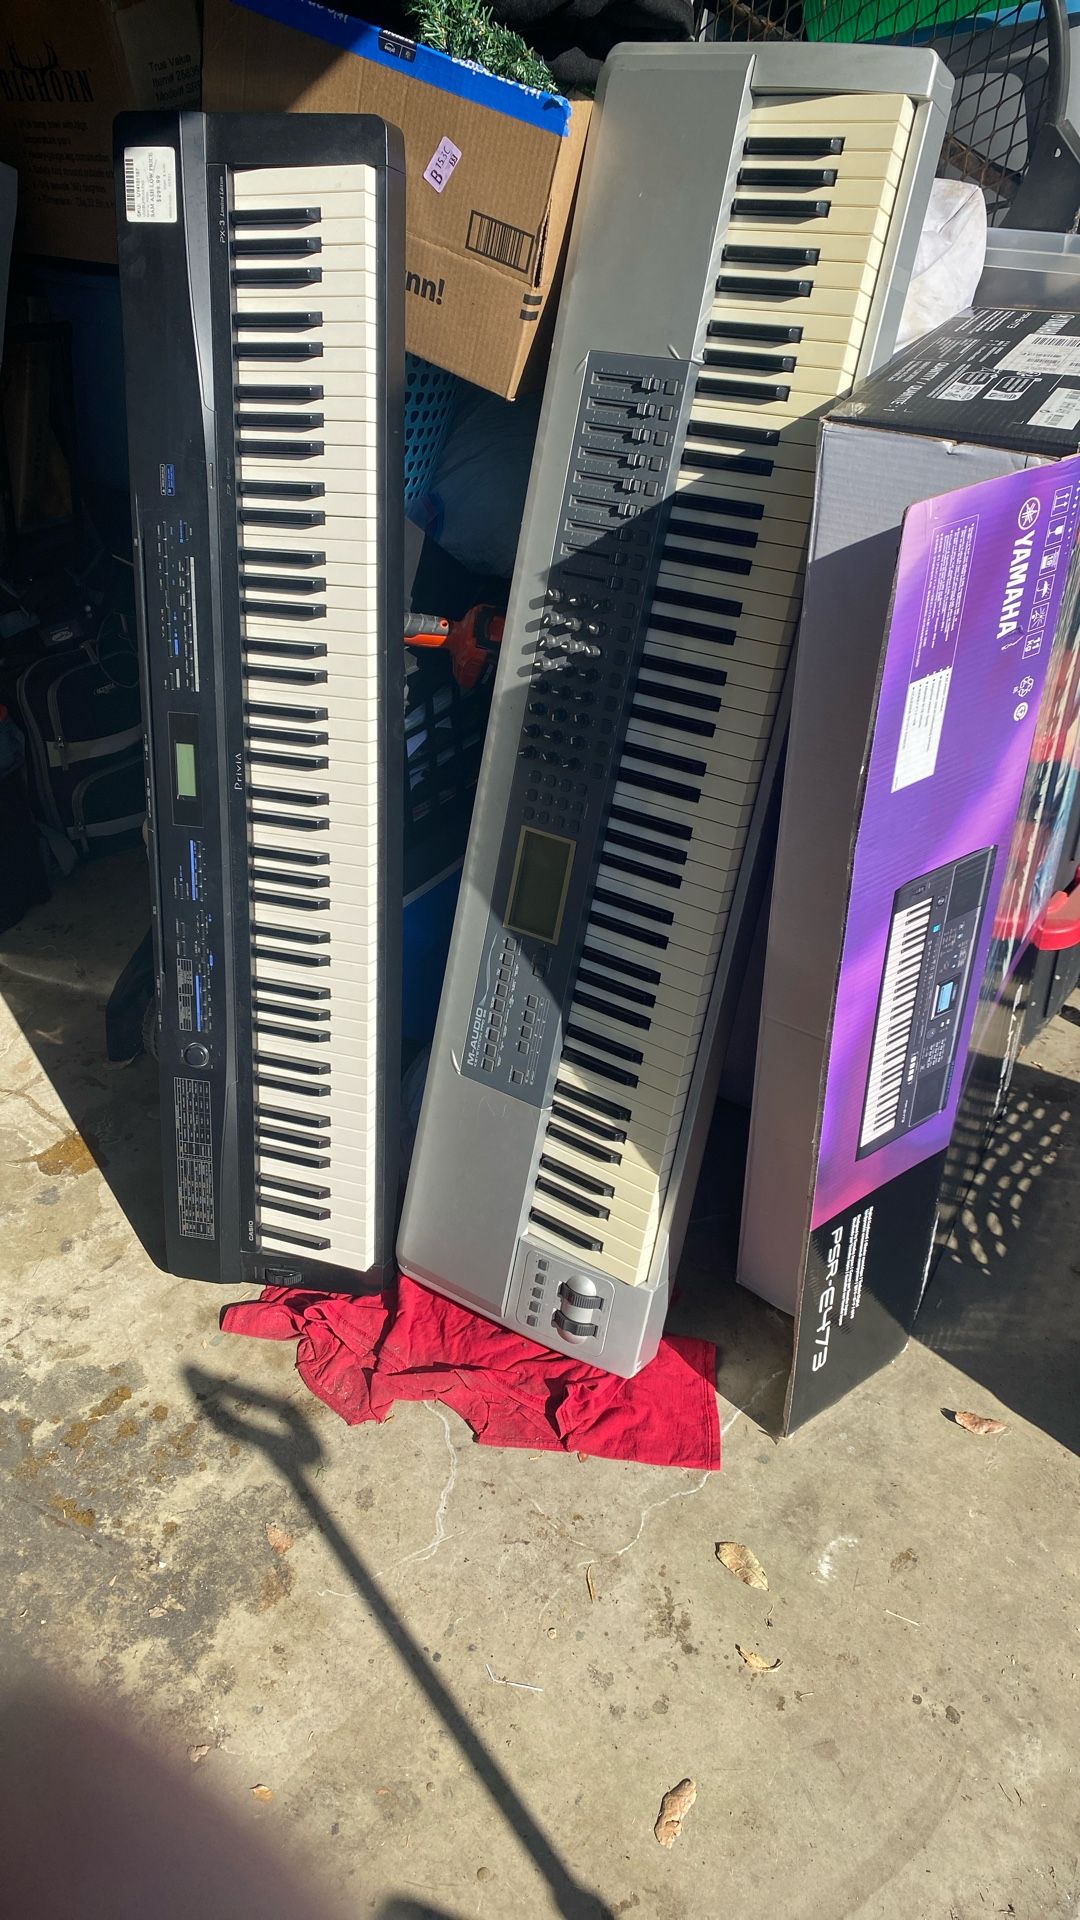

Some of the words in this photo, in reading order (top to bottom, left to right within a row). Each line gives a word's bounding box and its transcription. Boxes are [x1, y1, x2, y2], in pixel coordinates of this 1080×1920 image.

[430, 169, 443, 185] B
[404, 270, 445, 305] nn!
[996, 529, 1035, 639] YAMAHA
[467, 1007, 483, 1066] M-AUDIO
[812, 1225, 844, 1372] PSR-E473
